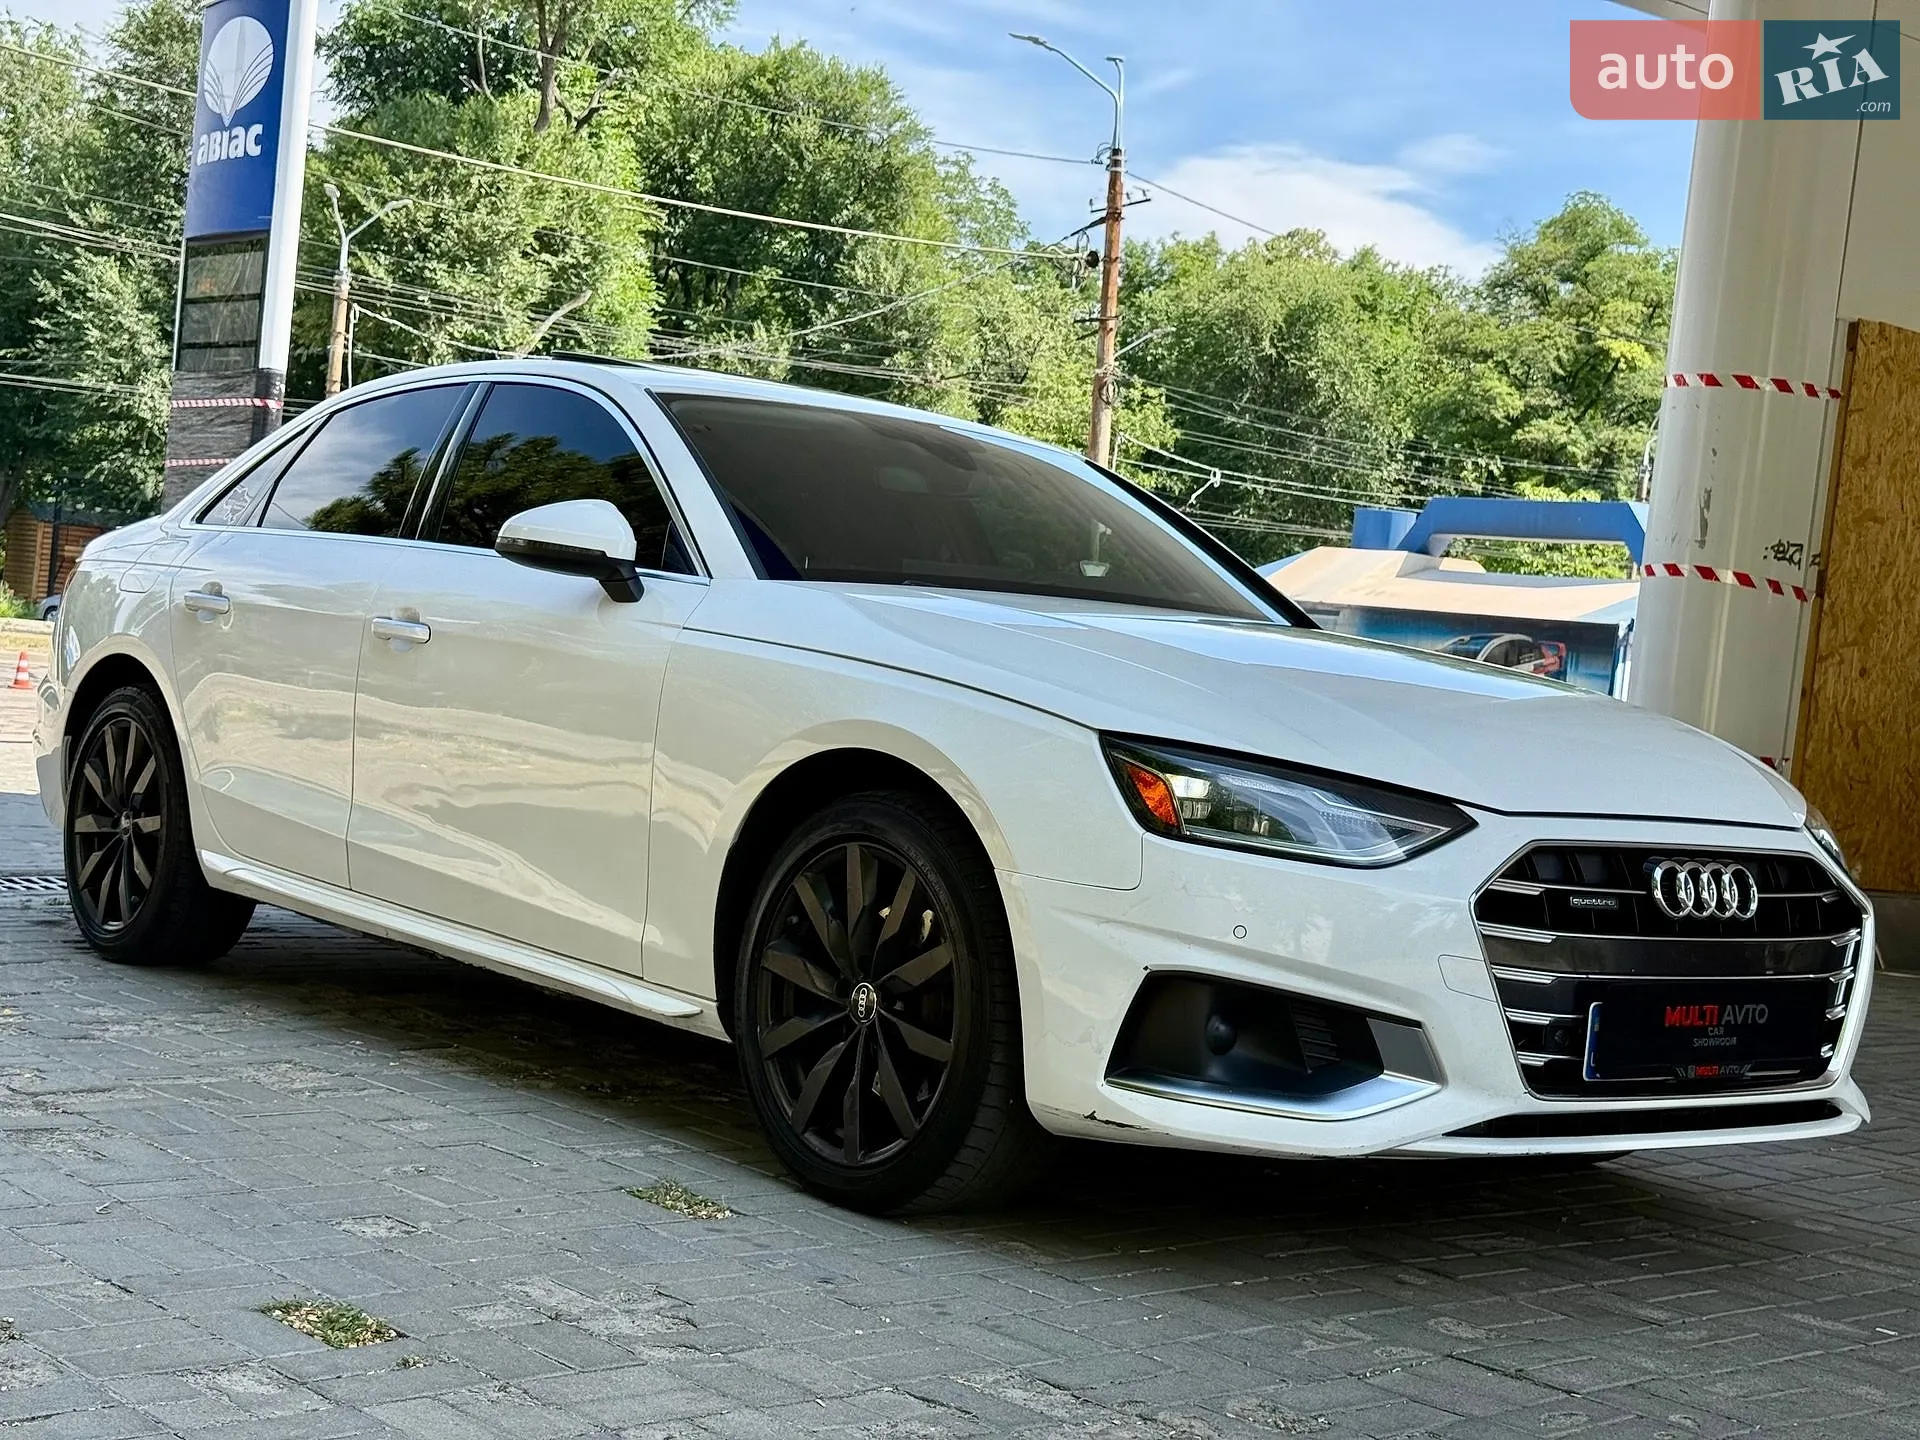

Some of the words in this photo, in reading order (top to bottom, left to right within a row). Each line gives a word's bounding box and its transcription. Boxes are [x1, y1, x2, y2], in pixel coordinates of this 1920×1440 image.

[1572, 898, 1615, 906] quattro
[1664, 1005, 1719, 1026] MULTI
[1721, 1003, 1769, 1025] AVTO
[1708, 1026, 1725, 1036] CAR
[1692, 1037, 1737, 1047] SHOWROOM
